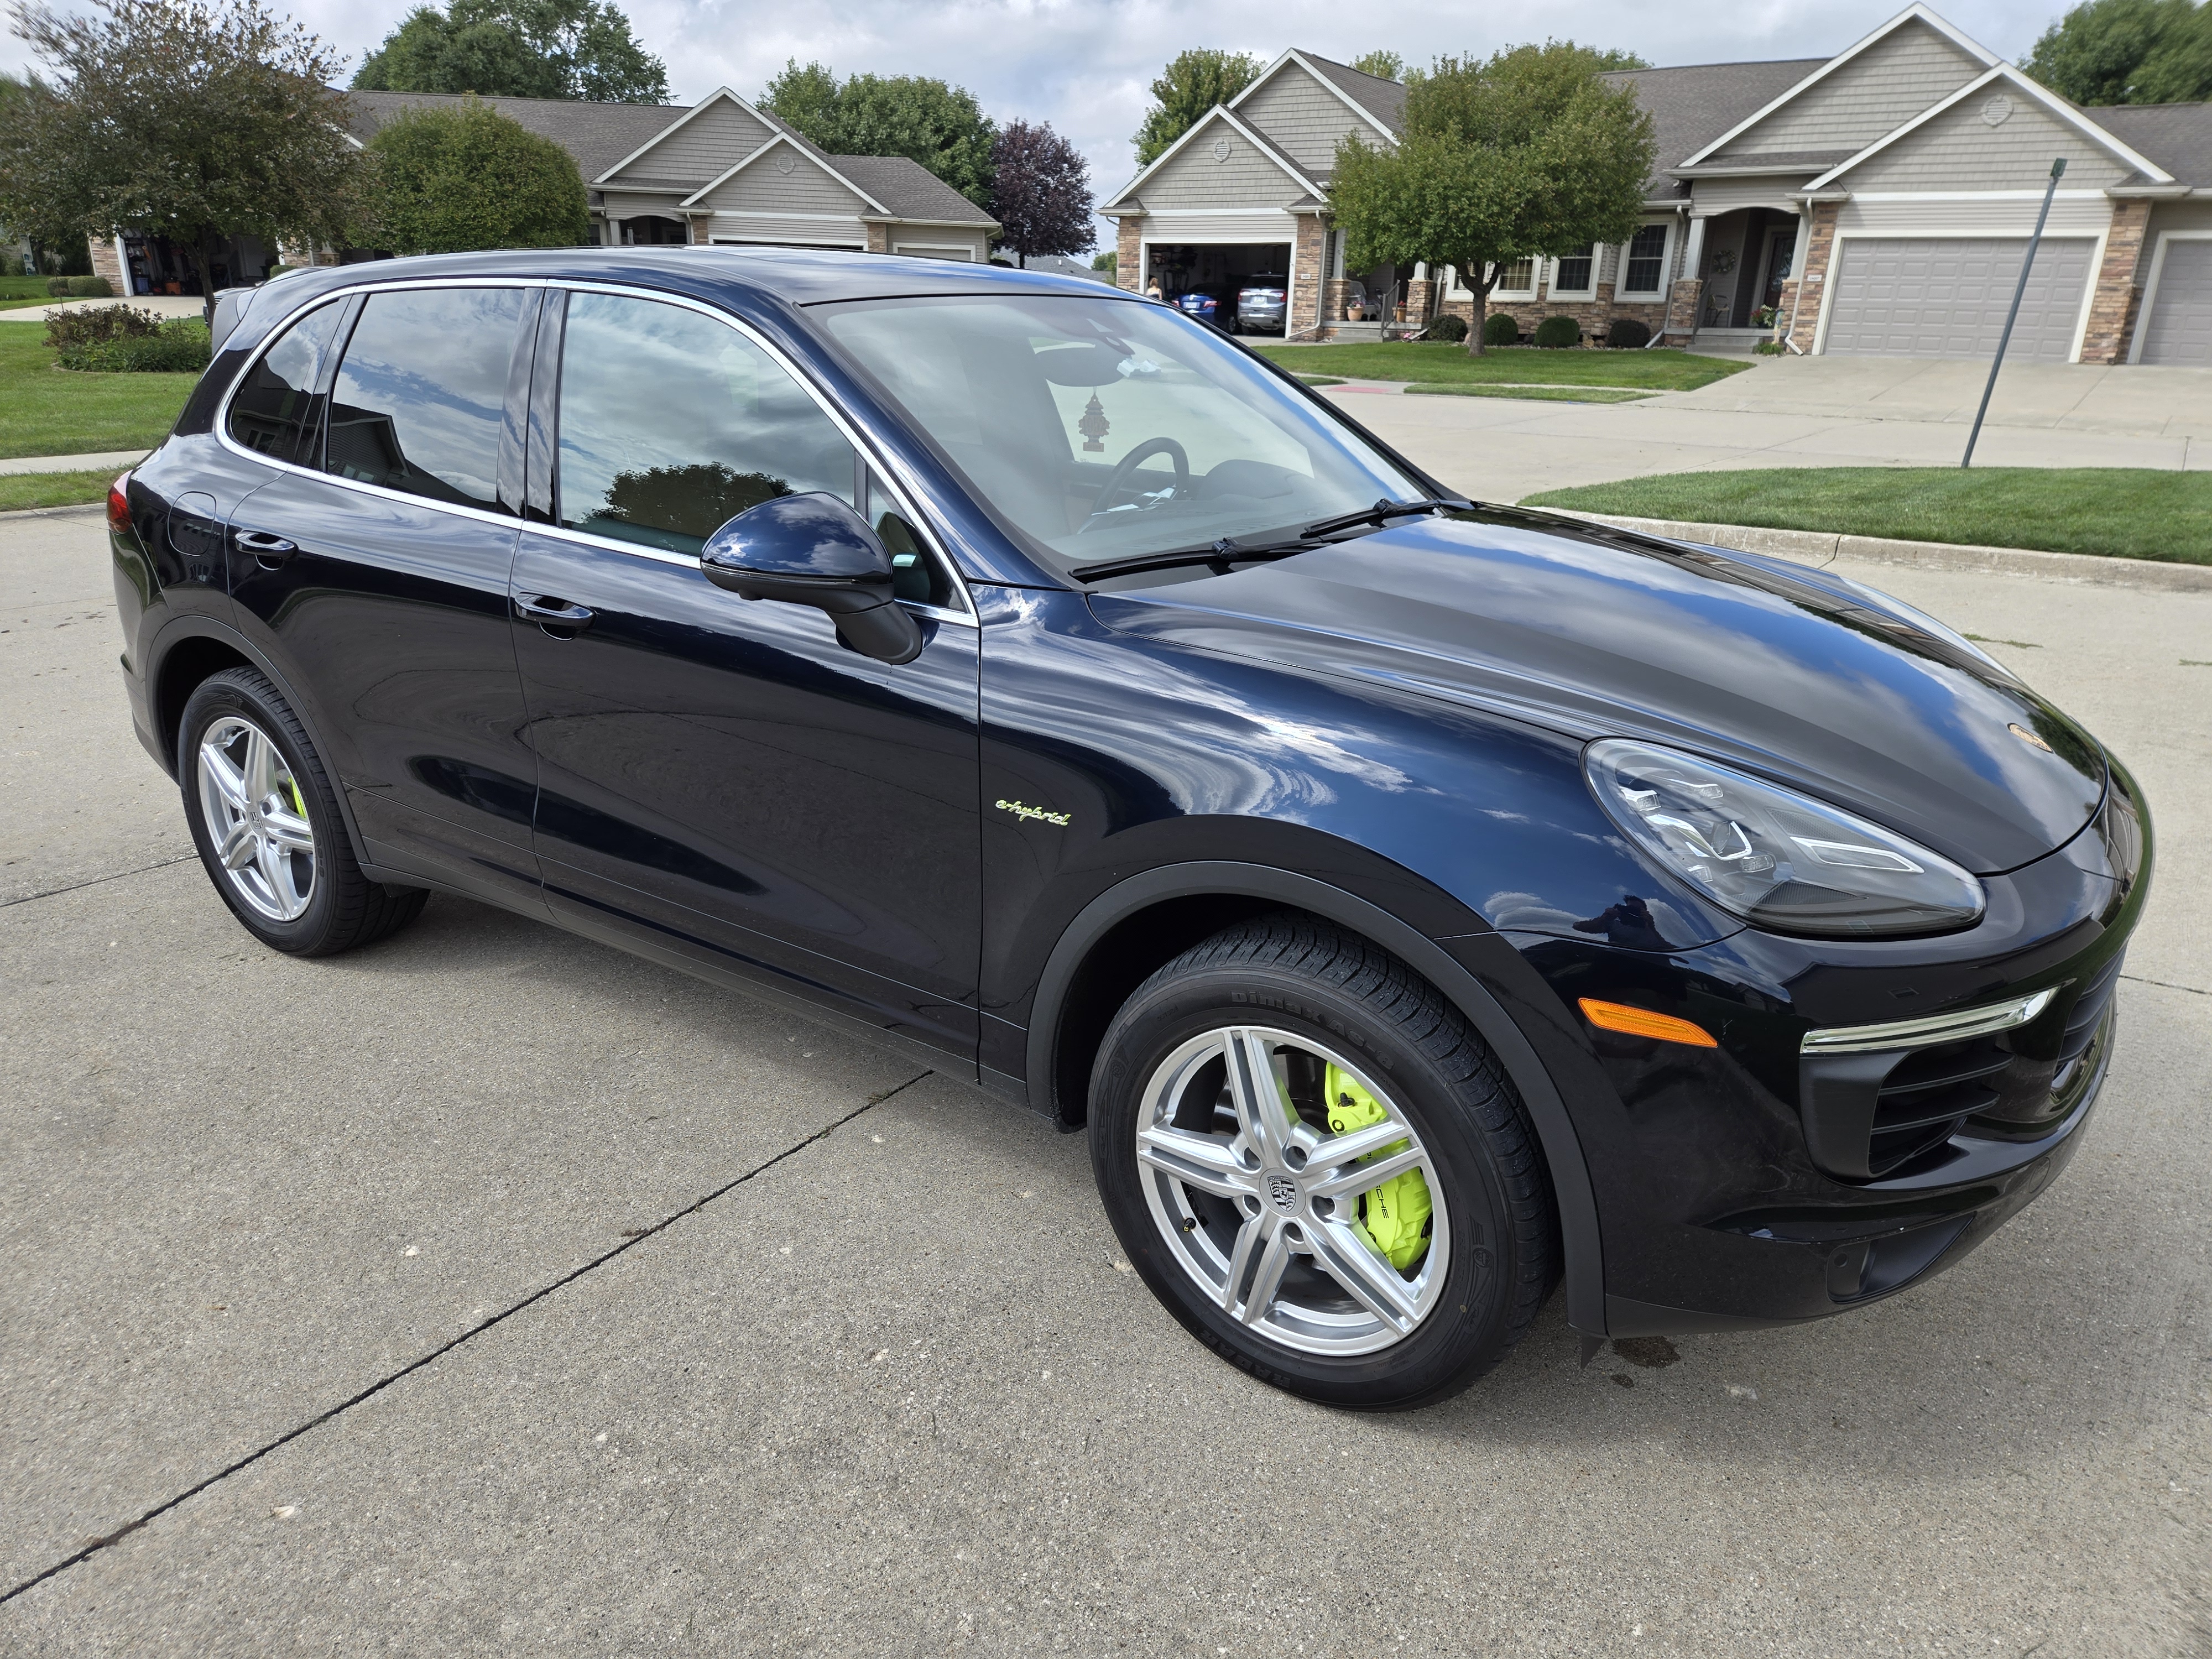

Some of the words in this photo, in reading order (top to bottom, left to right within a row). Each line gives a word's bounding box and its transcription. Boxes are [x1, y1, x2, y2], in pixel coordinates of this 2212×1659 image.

[995, 800, 1072, 826] e-hybrid
[1230, 990, 1323, 1022] Dimax
[1327, 1019, 1395, 1071] AS-8
